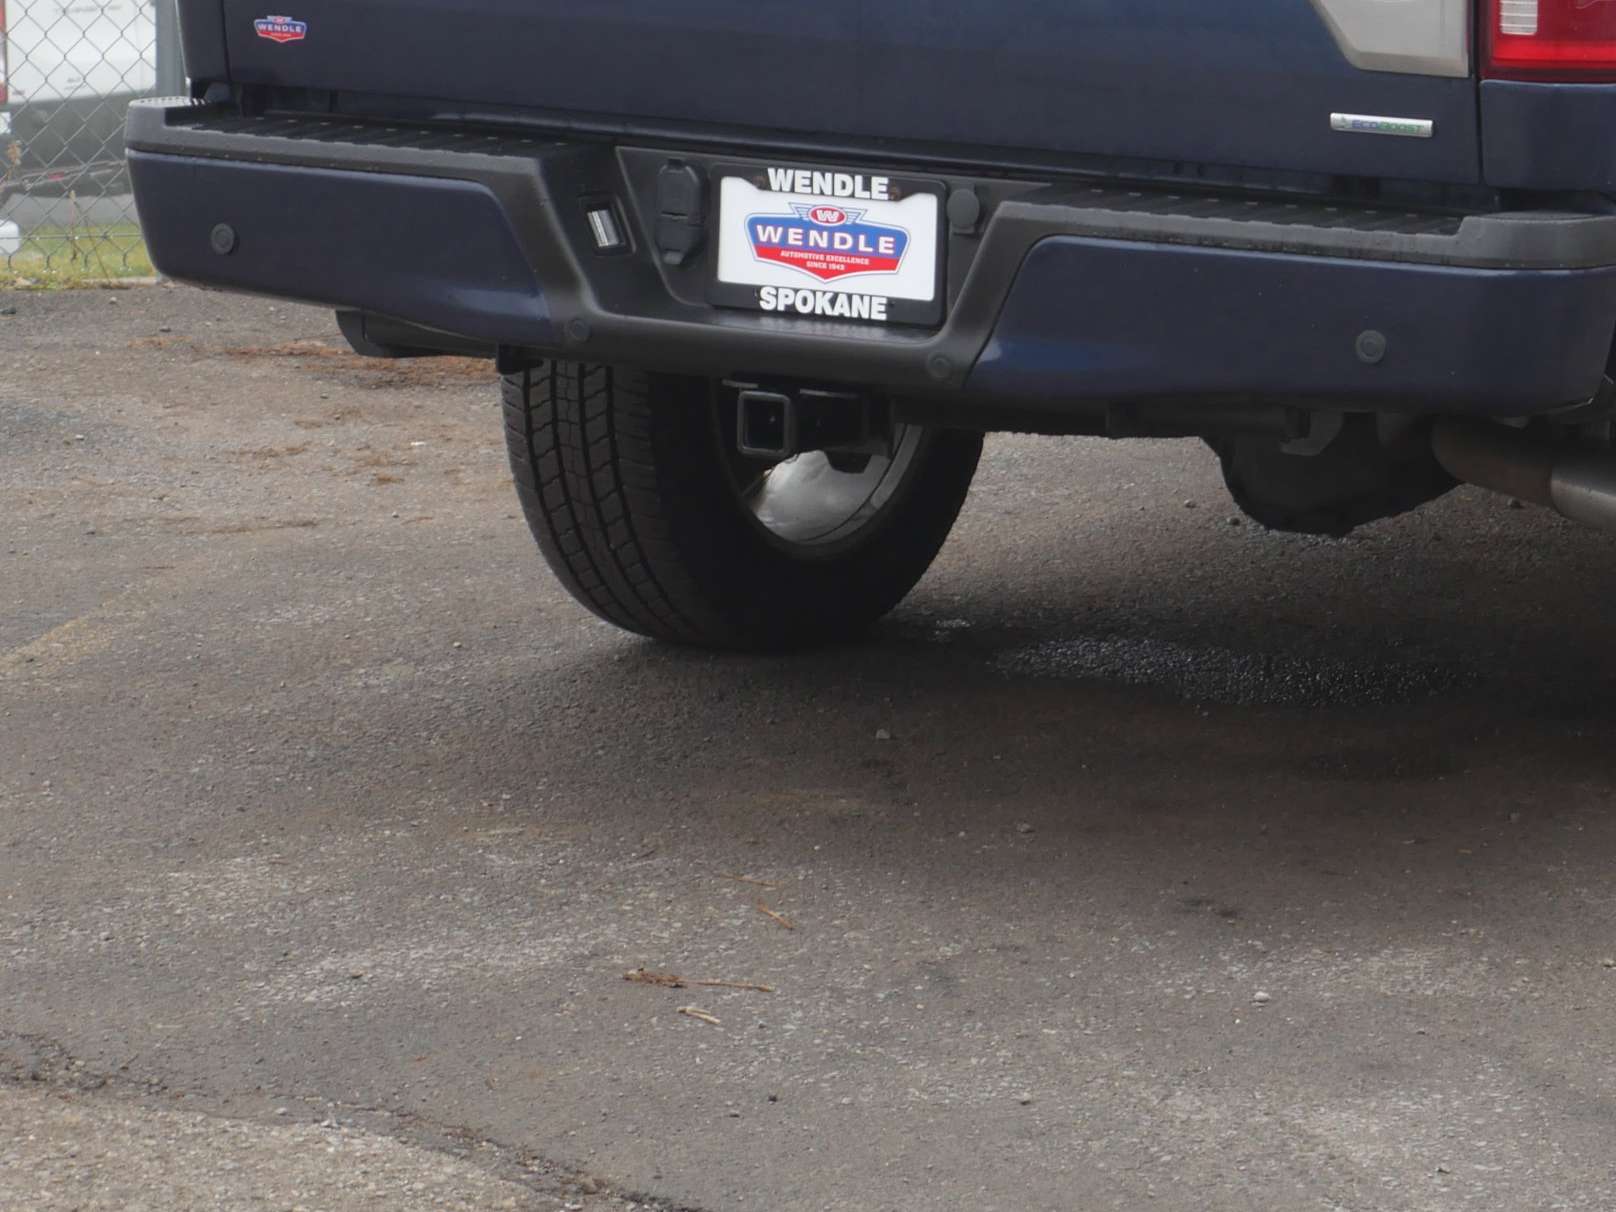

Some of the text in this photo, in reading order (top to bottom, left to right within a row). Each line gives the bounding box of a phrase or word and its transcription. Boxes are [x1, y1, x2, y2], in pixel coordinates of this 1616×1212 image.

[257, 23, 302, 33] WENDLE
[1351, 119, 1425, 133] ECOBOOST
[767, 168, 889, 200] WENDLE
[816, 208, 839, 223] W
[756, 224, 895, 255] WENDLE
[780, 250, 870, 265] AUTOMOTIVE EXCELLENCE
[806, 260, 828, 269] SINCE
[759, 286, 887, 321] SPOKANE
